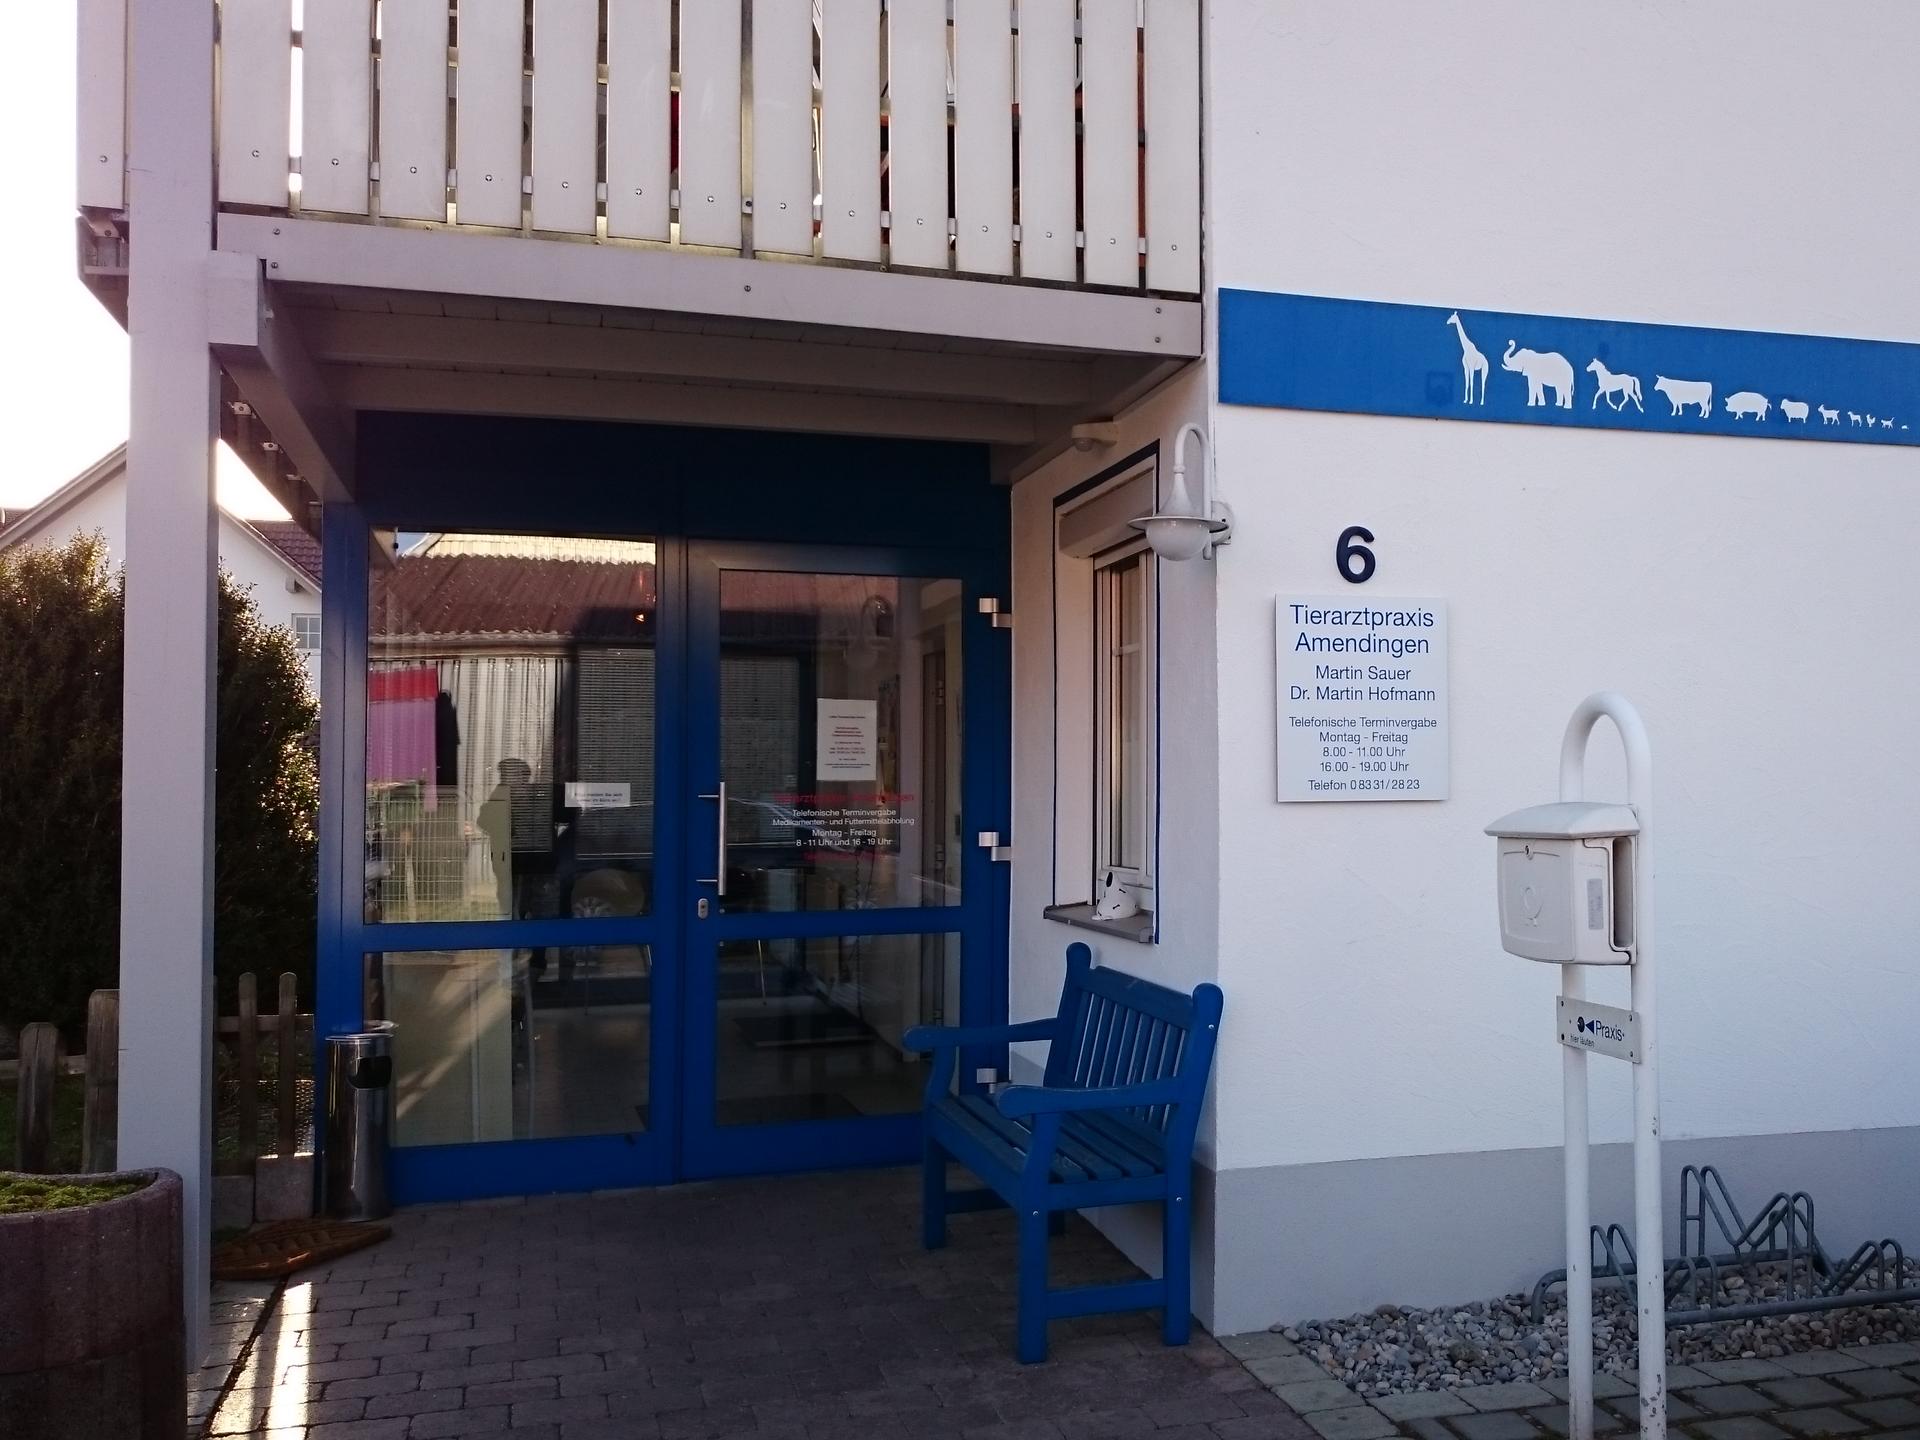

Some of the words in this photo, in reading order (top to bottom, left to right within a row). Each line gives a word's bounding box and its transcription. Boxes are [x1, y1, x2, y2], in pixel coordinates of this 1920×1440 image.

[1336, 526, 1376, 584] 6
[1290, 604, 1434, 630] Tierarztpraxis
[1295, 632, 1429, 658] Amendingen
[1316, 665, 1363, 680] Martin
[1368, 665, 1411, 680] Sauer
[1290, 686, 1310, 700] Dr.
[1316, 686, 1363, 700] Martin
[1368, 686, 1435, 701] Hofmann
[1289, 716, 1356, 728] Telefonische
[1360, 717, 1437, 730] Terminvergabe
[1319, 731, 1361, 745] Montag
[1372, 731, 1408, 745] Freitag
[1322, 746, 1347, 757] 8.00
[1357, 746, 1383, 757] 11.00
[1386, 746, 1406, 757] Uhr
[1320, 761, 1349, 772] 16.00
[1360, 761, 1387, 772] 19.00
[1390, 761, 1409, 772] Uhr
[1308, 779, 1347, 791] Telefon
[792, 808, 840, 817] Telefonische
[842, 808, 897, 817] Terminvergabe
[812, 829, 842, 837] Montag
[850, 828, 877, 837] Freitag
[796, 839, 802, 847] 8
[808, 839, 816, 847] 11
[818, 838, 833, 846] Uhr
[834, 838, 850, 846] und
[852, 838, 861, 847] 16
[867, 837, 876, 846] 19
[877, 837, 893, 846] Uhr
[1595, 1020, 1623, 1041] Praxis
